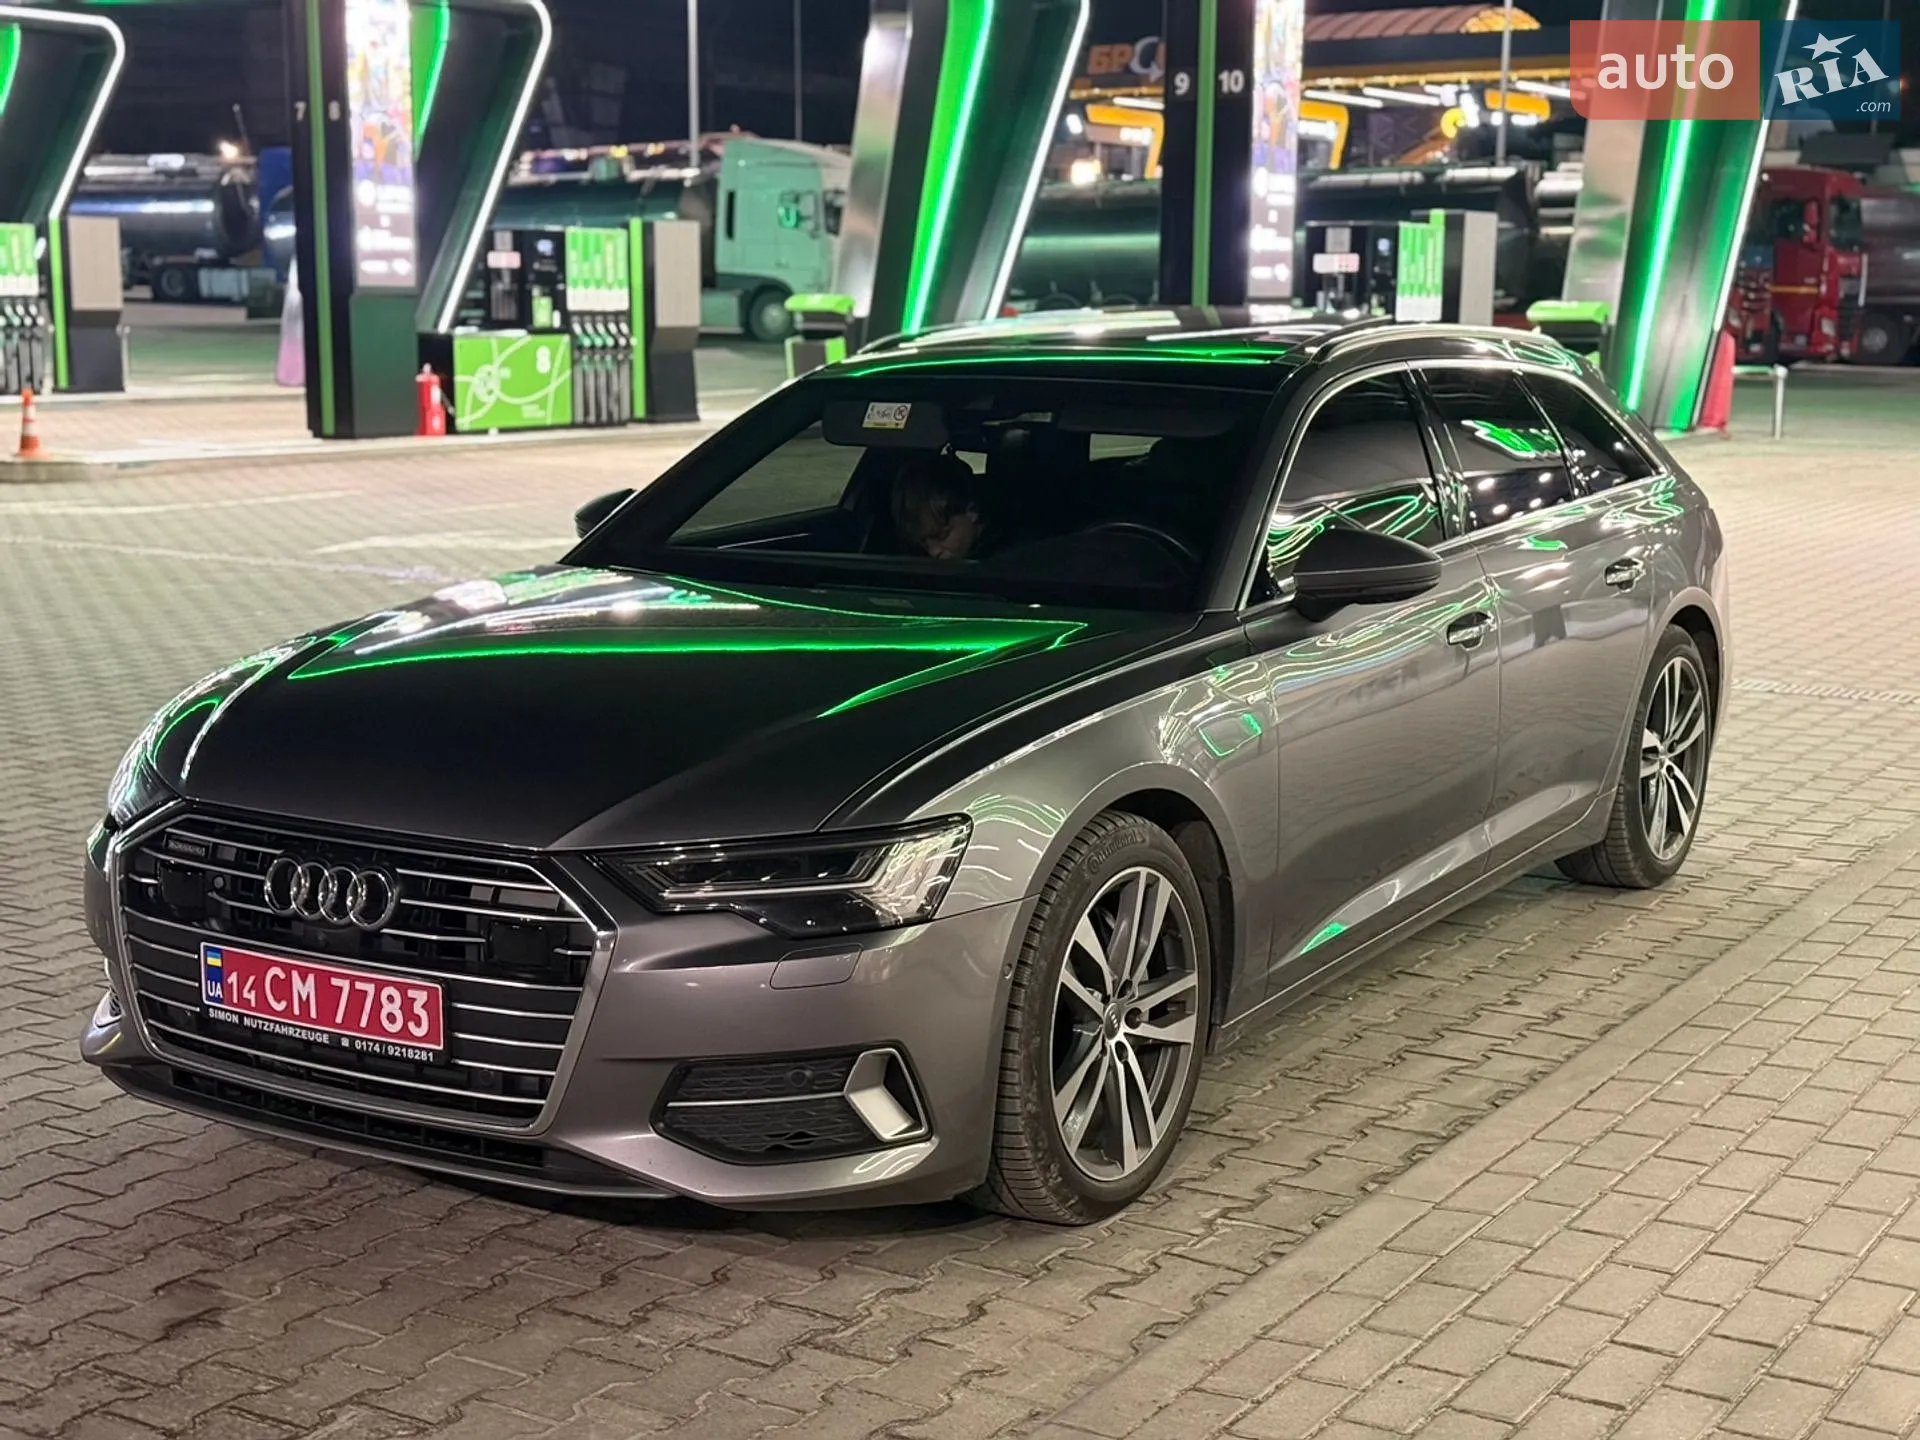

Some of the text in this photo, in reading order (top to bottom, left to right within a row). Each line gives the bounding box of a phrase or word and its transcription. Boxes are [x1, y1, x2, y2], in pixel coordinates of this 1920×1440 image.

[1174, 72, 1190, 96] 9
[1218, 69, 1245, 93] 10
[294, 101, 306, 121] 7
[536, 346, 551, 374] 8
[207, 980, 223, 999] UA
[227, 966, 429, 1037] 14 CM 7783
[209, 1007, 239, 1025] SIMON
[243, 1017, 330, 1044] NUTZFAHRZEUGE
